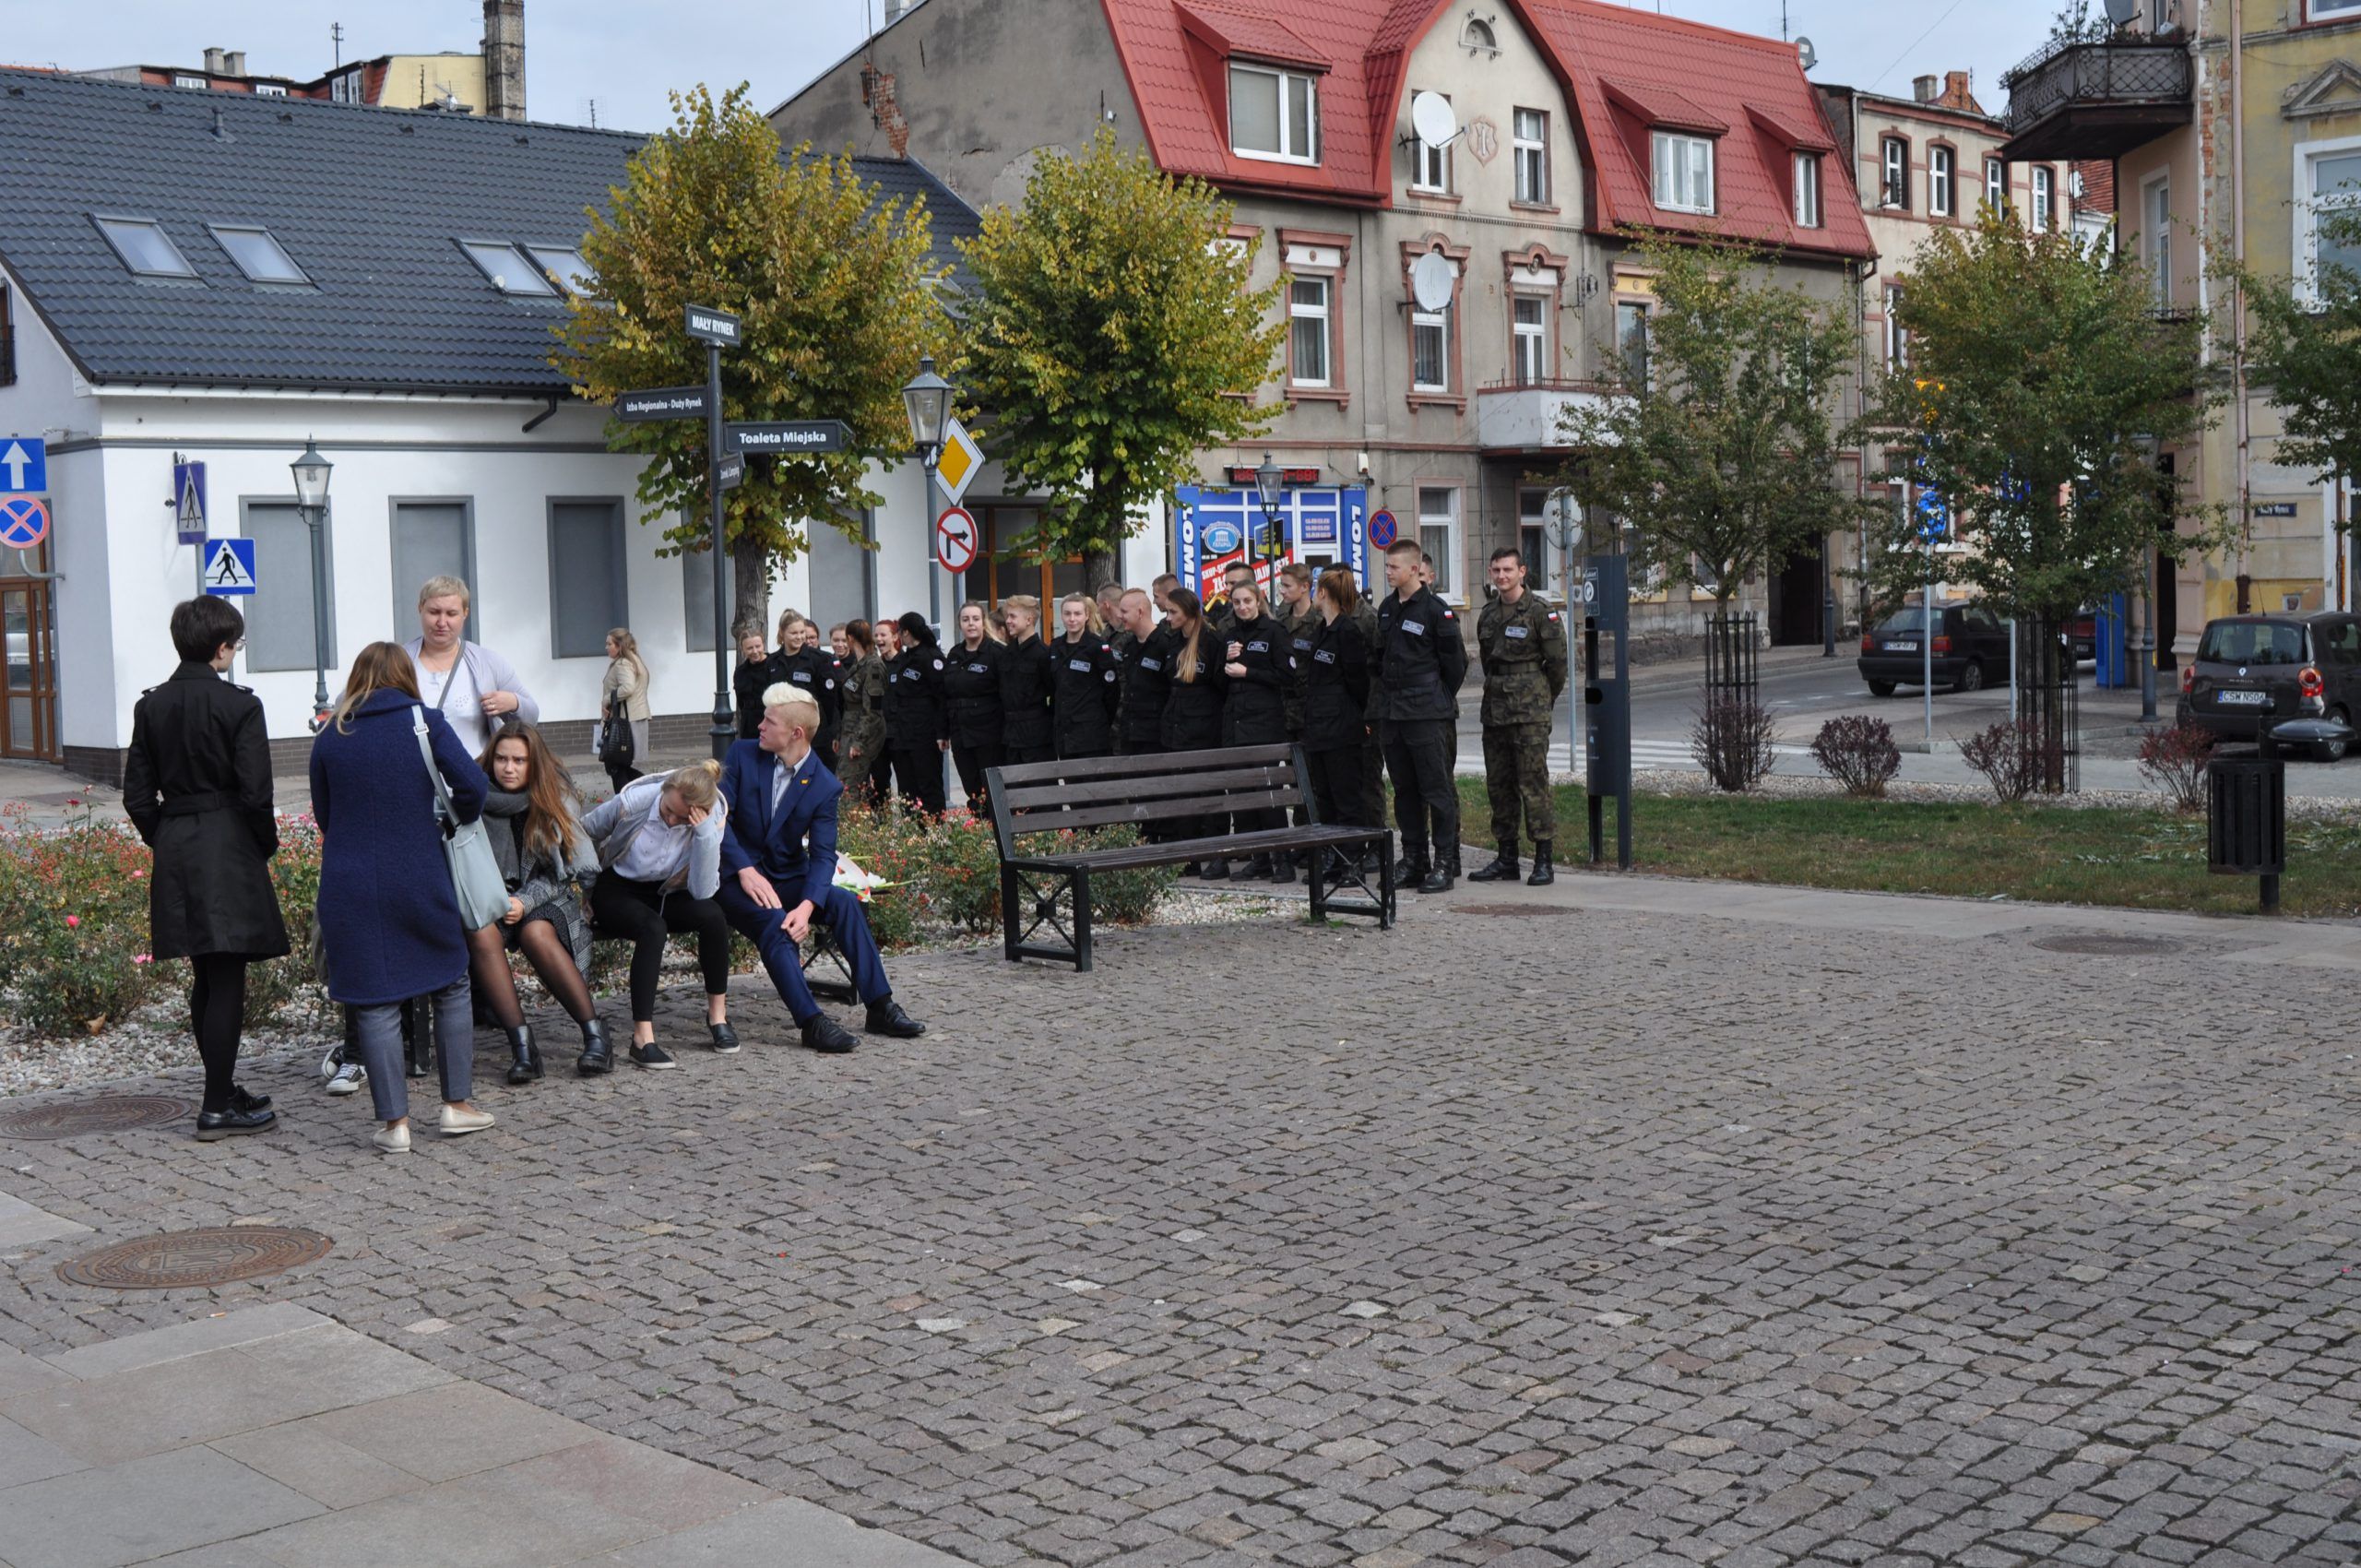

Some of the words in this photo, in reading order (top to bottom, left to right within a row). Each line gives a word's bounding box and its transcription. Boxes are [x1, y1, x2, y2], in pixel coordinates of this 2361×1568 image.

[692, 315, 711, 331] MAŁY
[712, 319, 734, 337] RYNEK
[627, 402, 637, 412] Izba
[638, 400, 668, 413] Regionalna
[671, 398, 684, 410] Duży
[685, 397, 703, 410] Rynek
[739, 433, 780, 444] Toaleta
[783, 431, 826, 445] Miejska
[2224, 692, 2241, 701] CSW
